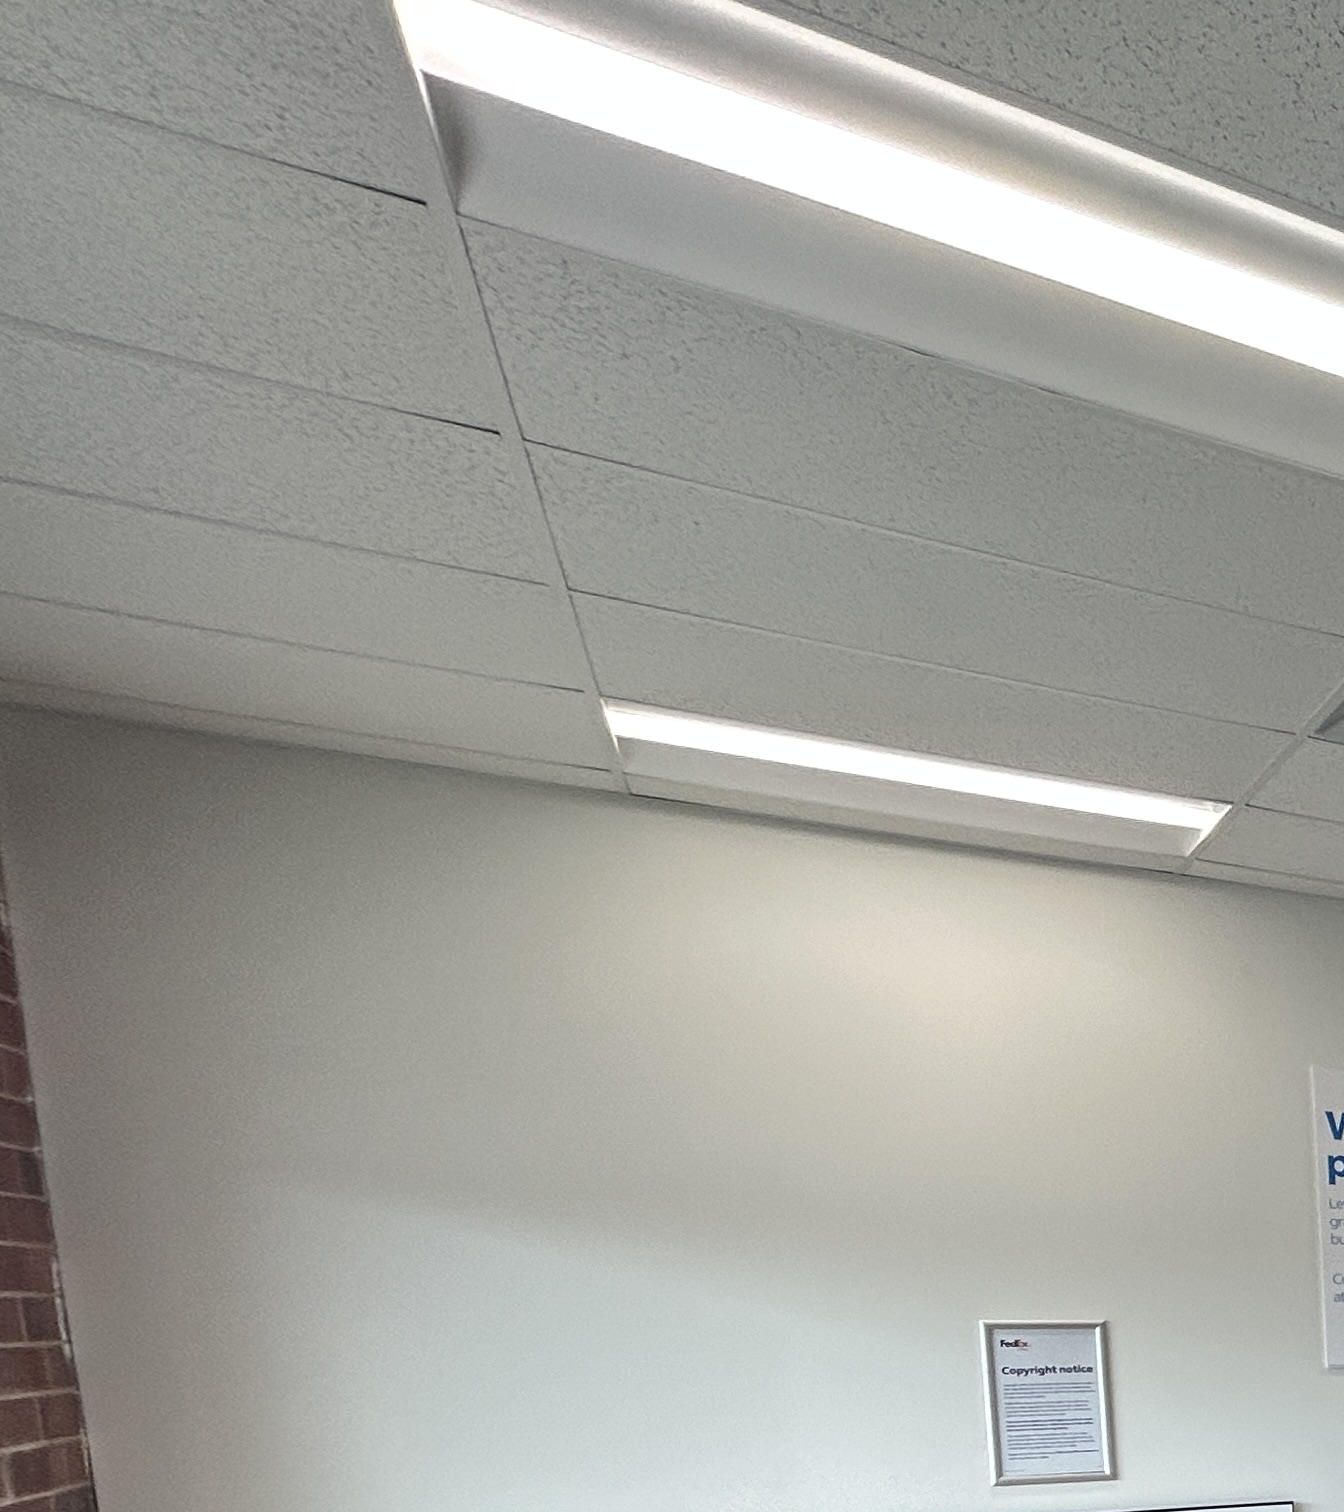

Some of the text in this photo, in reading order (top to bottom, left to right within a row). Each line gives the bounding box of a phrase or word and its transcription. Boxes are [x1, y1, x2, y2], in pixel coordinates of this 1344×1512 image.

[1000, 1339, 1029, 1348] FedEx
[1001, 1363, 1094, 1377] Copyright notice
